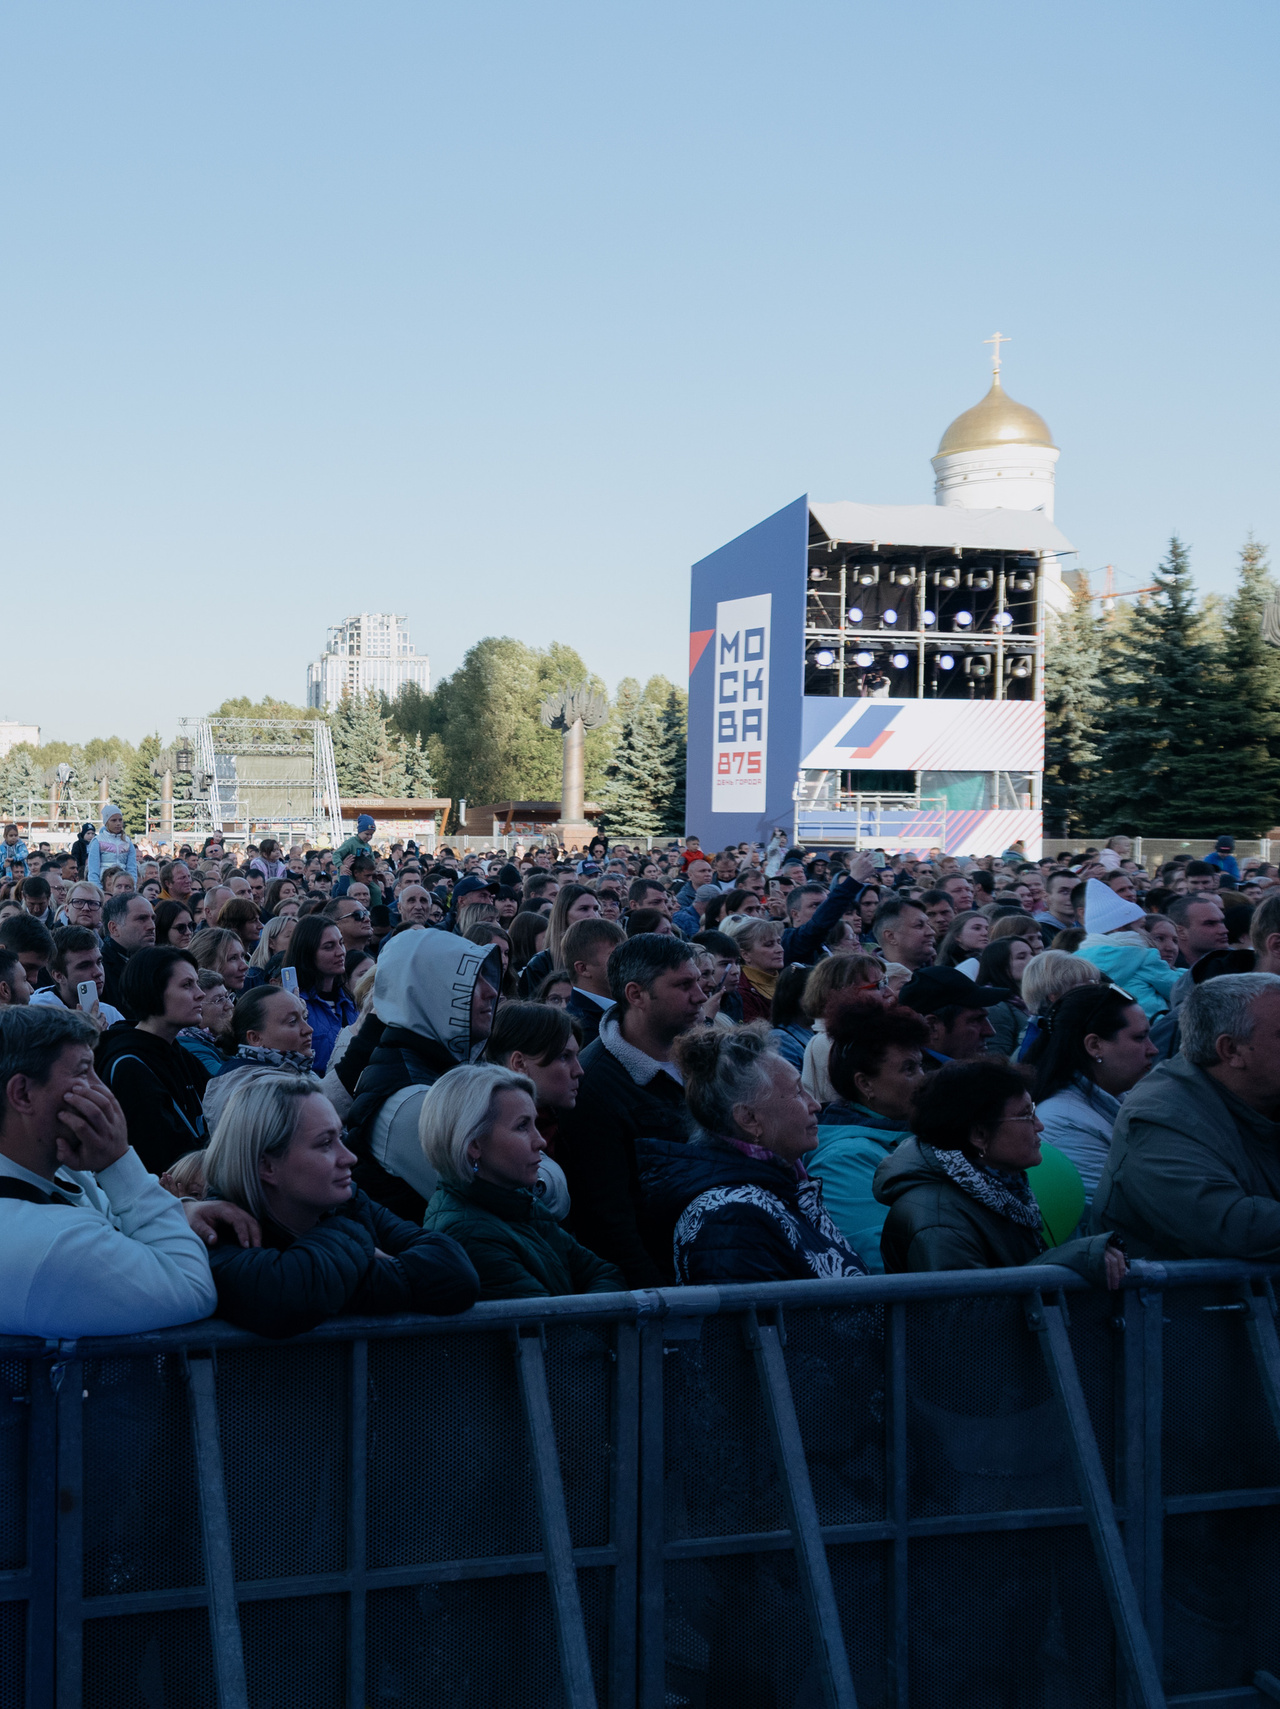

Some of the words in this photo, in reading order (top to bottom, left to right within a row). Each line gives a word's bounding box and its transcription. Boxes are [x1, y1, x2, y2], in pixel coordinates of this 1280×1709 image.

[720, 626, 766, 665] МО
[719, 667, 764, 704] СК
[718, 707, 763, 743] ВА
[717, 751, 762, 775] 875
[735, 778, 762, 786] ГОРОДА
